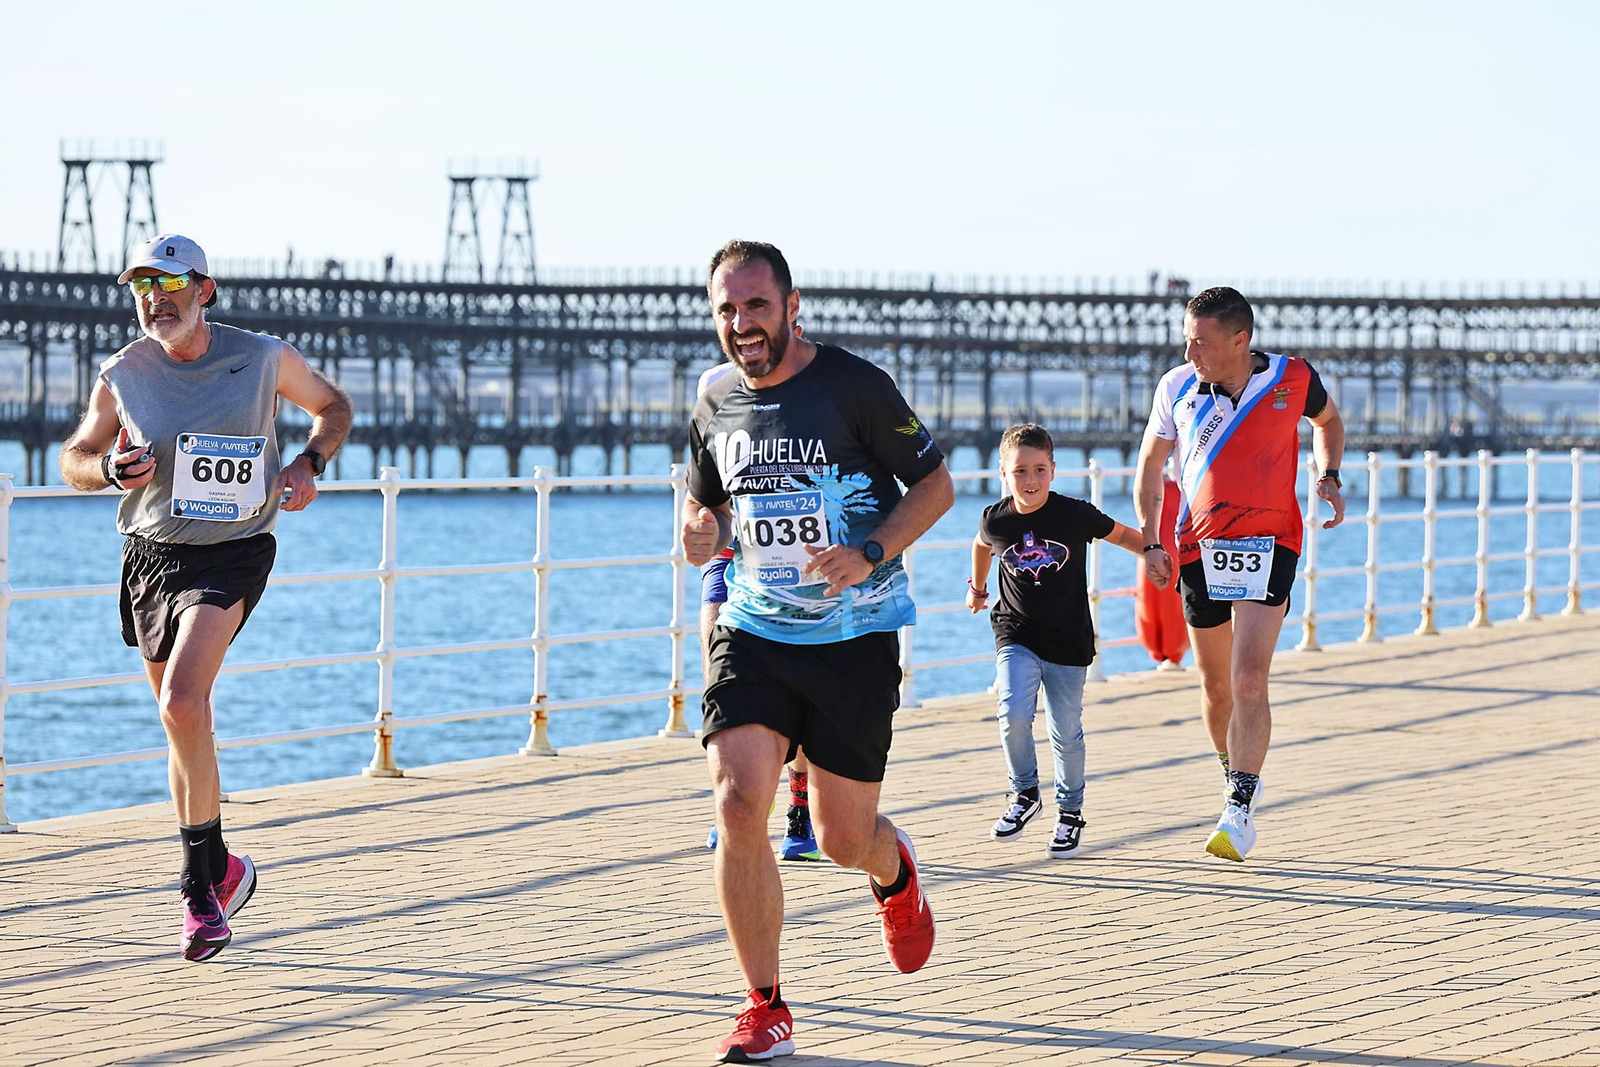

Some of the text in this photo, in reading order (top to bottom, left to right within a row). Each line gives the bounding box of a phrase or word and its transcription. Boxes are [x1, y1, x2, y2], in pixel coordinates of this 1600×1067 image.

[197, 439, 219, 449] HUELVA
[221, 442, 249, 451] AVATEL
[750, 438, 827, 465] HUELVA
[192, 456, 253, 485] 608
[750, 465, 768, 474] PUERTA
[769, 464, 778, 473] DEL
[743, 477, 792, 490] AVATE
[189, 502, 234, 514] Wayalia
[746, 497, 817, 510] ELVA AVATEL '24
[743, 516, 821, 548] 1038
[1255, 540, 1271, 550] '24
[1213, 551, 1261, 572] 953
[1211, 586, 1244, 596] Wayalia
